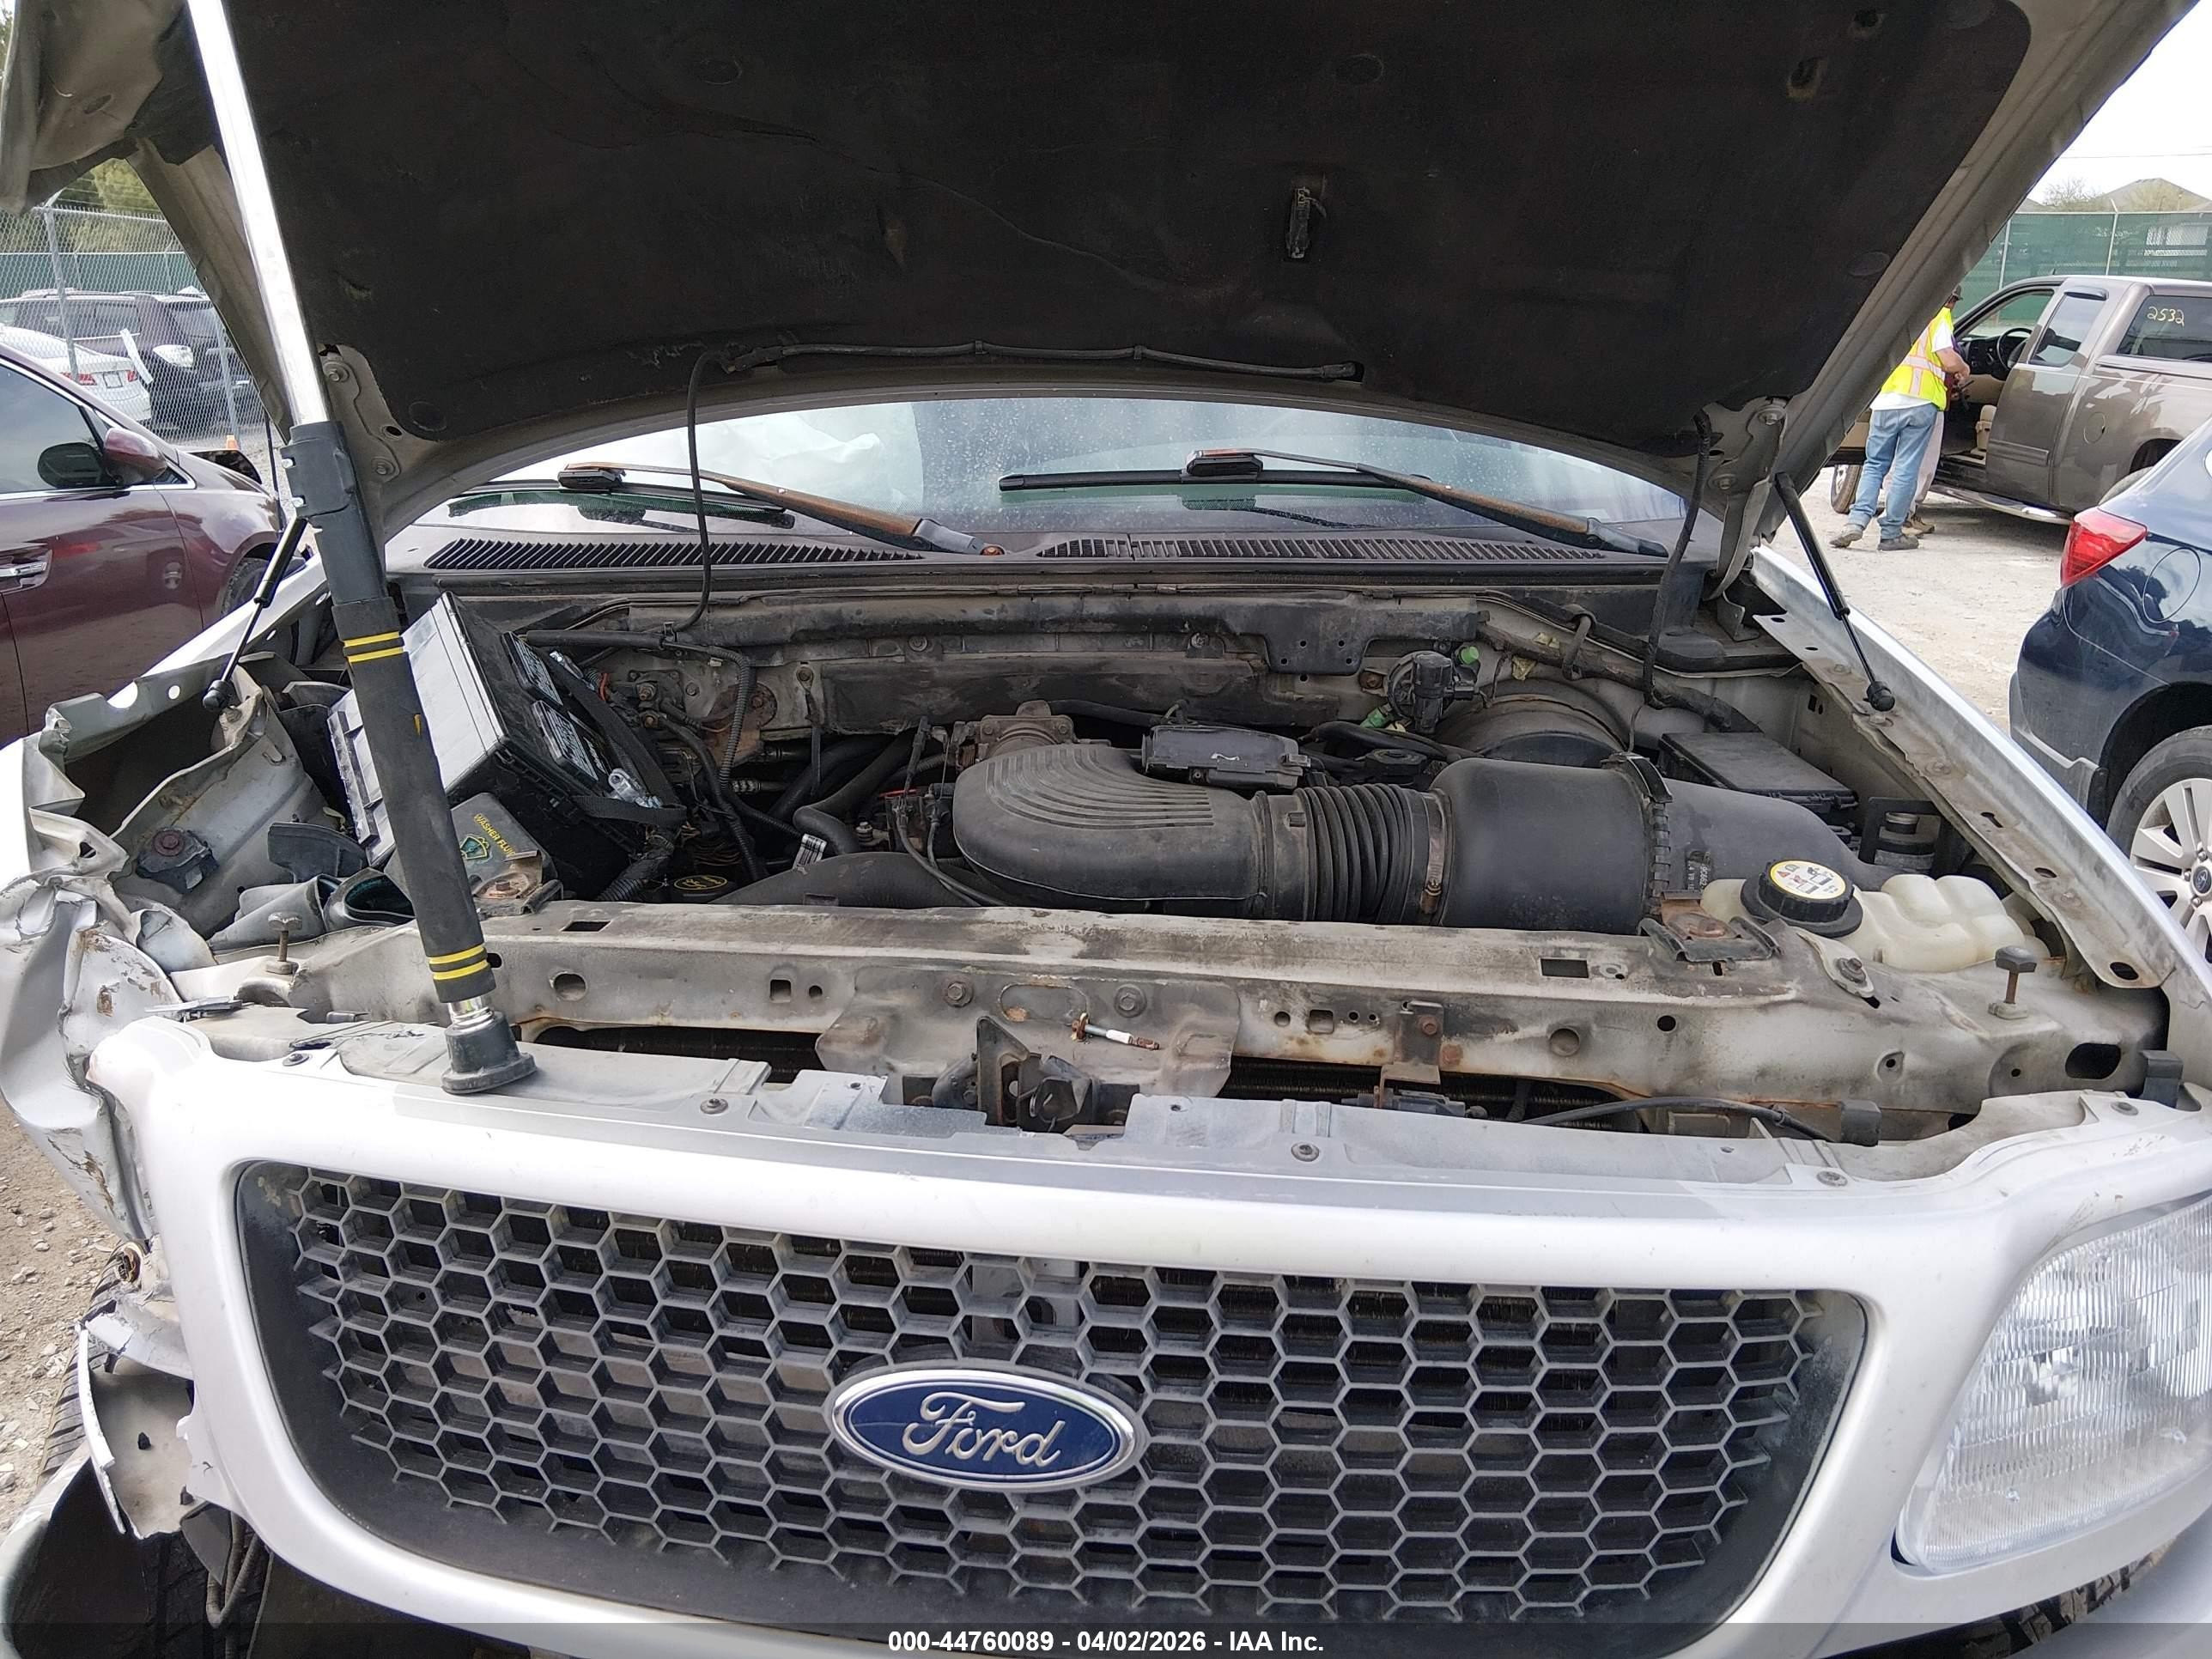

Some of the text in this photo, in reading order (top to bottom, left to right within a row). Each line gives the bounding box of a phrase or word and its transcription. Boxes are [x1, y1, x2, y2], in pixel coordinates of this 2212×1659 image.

[2147, 306, 2185, 326] 2532
[473, 812, 501, 842] WASHER
[902, 1391, 1065, 1468] Ford
